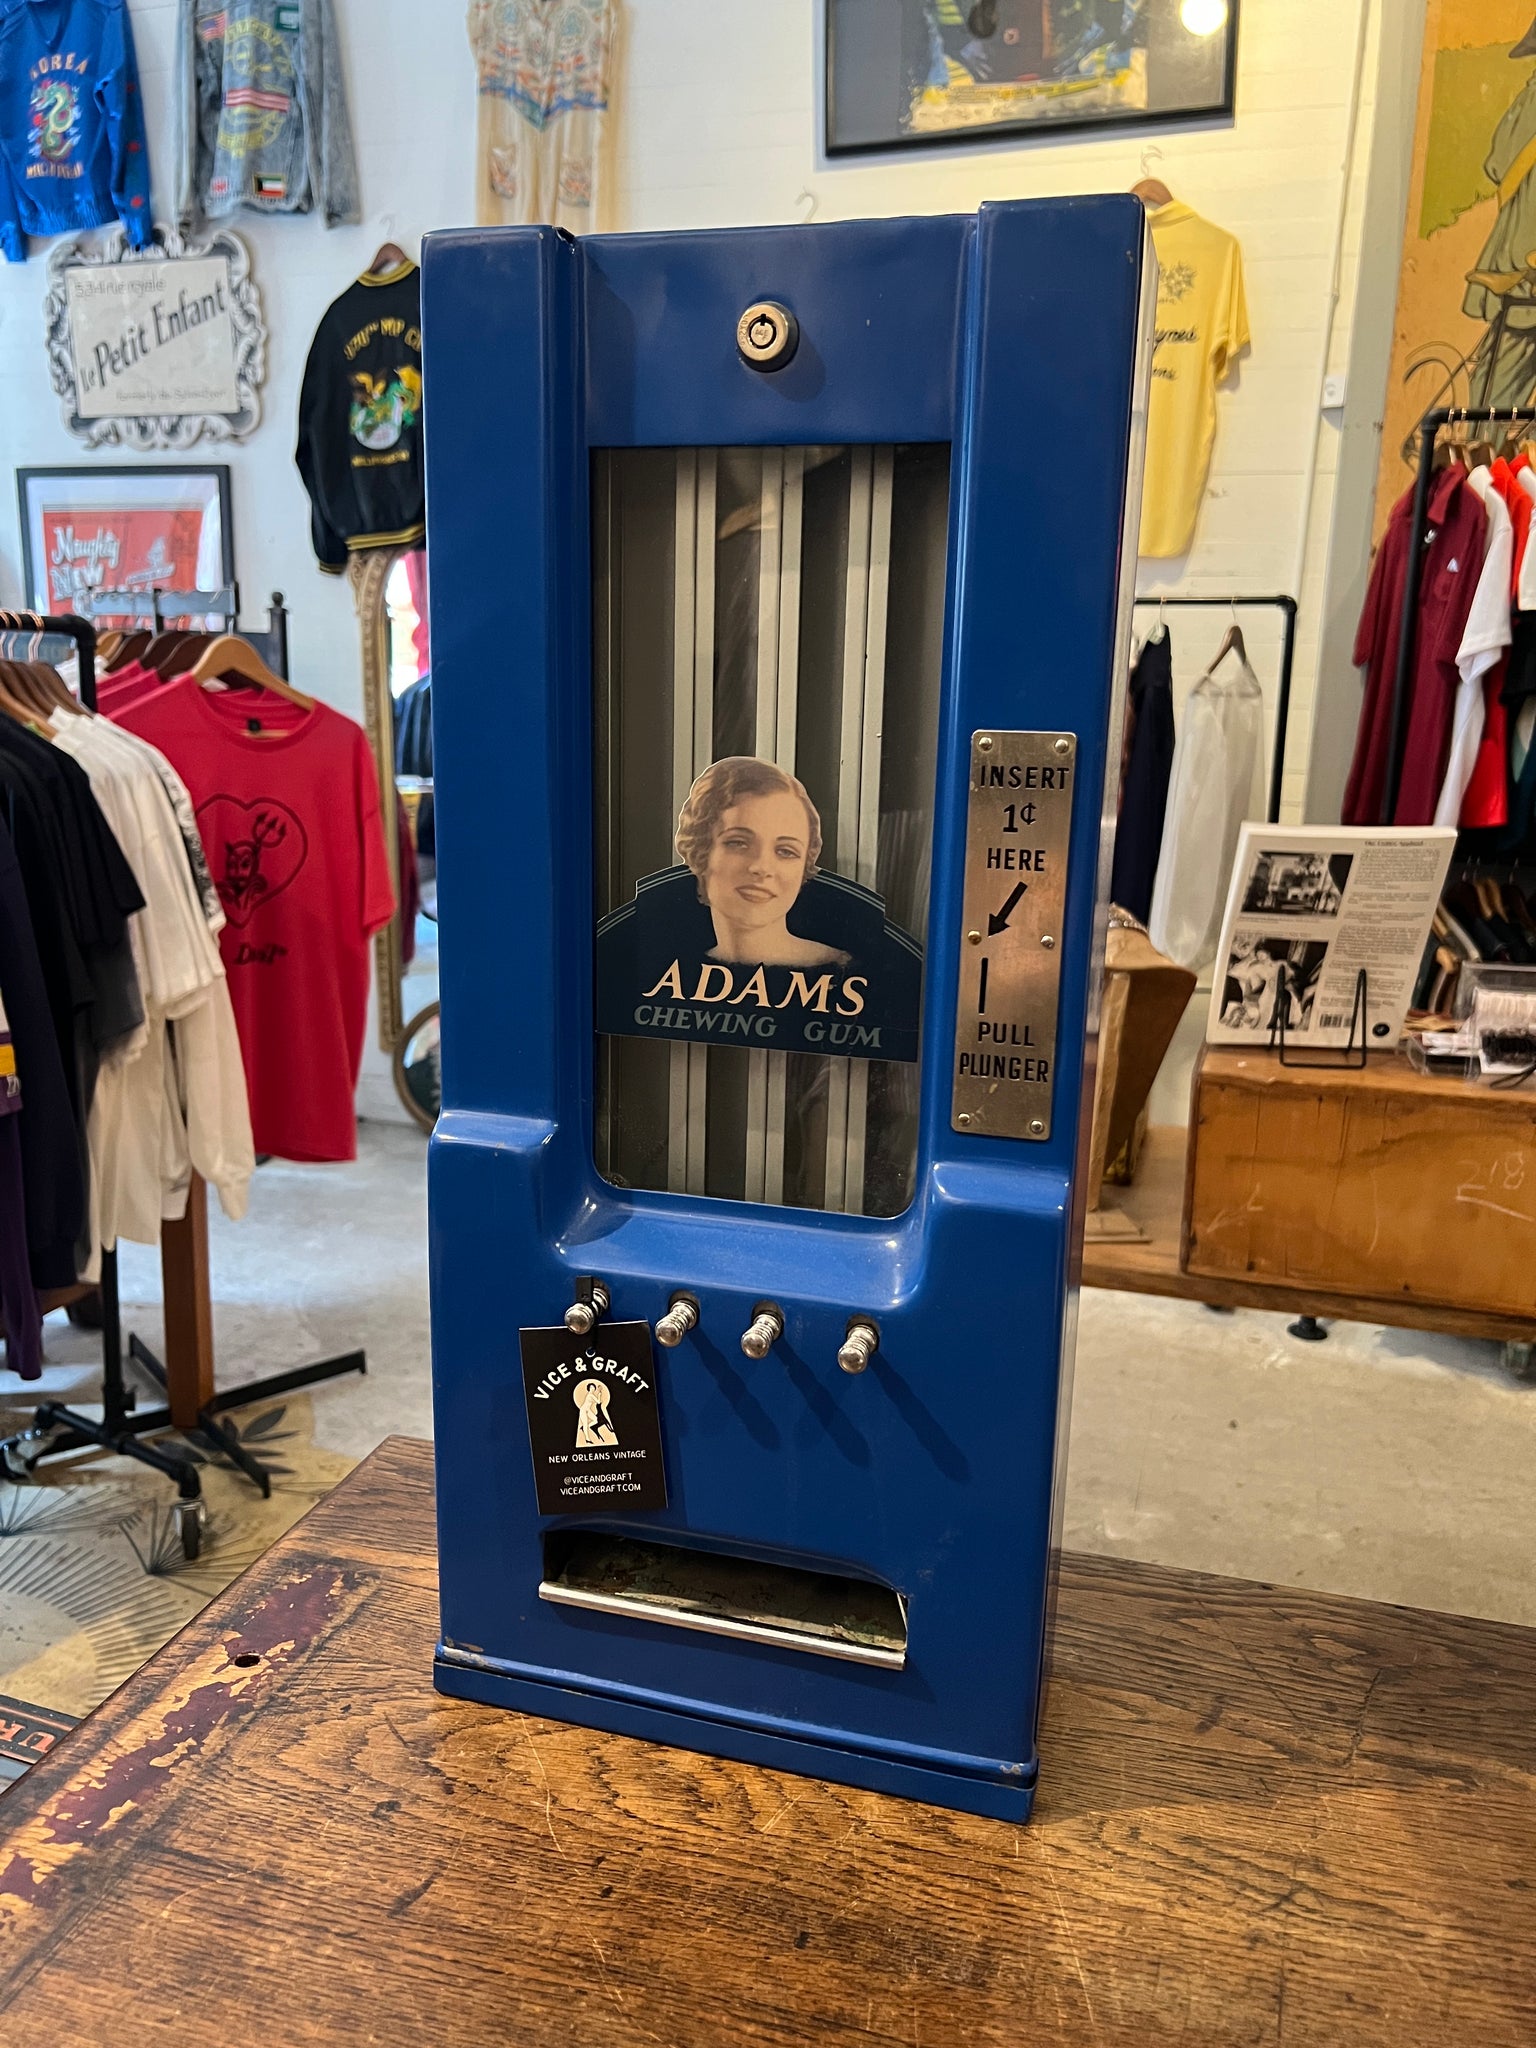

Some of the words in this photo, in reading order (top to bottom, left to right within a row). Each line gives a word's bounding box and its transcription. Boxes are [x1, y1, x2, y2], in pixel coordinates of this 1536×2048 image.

[94, 323, 149, 387] Petit
[152, 279, 225, 346] Enfant
[980, 765, 1070, 790] INSERT
[1003, 802, 1037, 833] 1¢
[987, 847, 1046, 872] HERE
[641, 958, 868, 1016] ADAMS
[633, 1004, 778, 1038] CHEWING
[803, 1021, 882, 1048] GUM
[977, 1021, 1035, 1047] PULL
[959, 1052, 1049, 1083] PLUNGER
[533, 1362, 572, 1400] VICE
[575, 1357, 588, 1373] &
[592, 1357, 649, 1393] GRAFT
[549, 1454, 568, 1464] NEW
[572, 1452, 611, 1462] ORLEANS
[613, 1450, 646, 1460] VINTAGE
[563, 1472, 632, 1485] @VICEANDGRAFT
